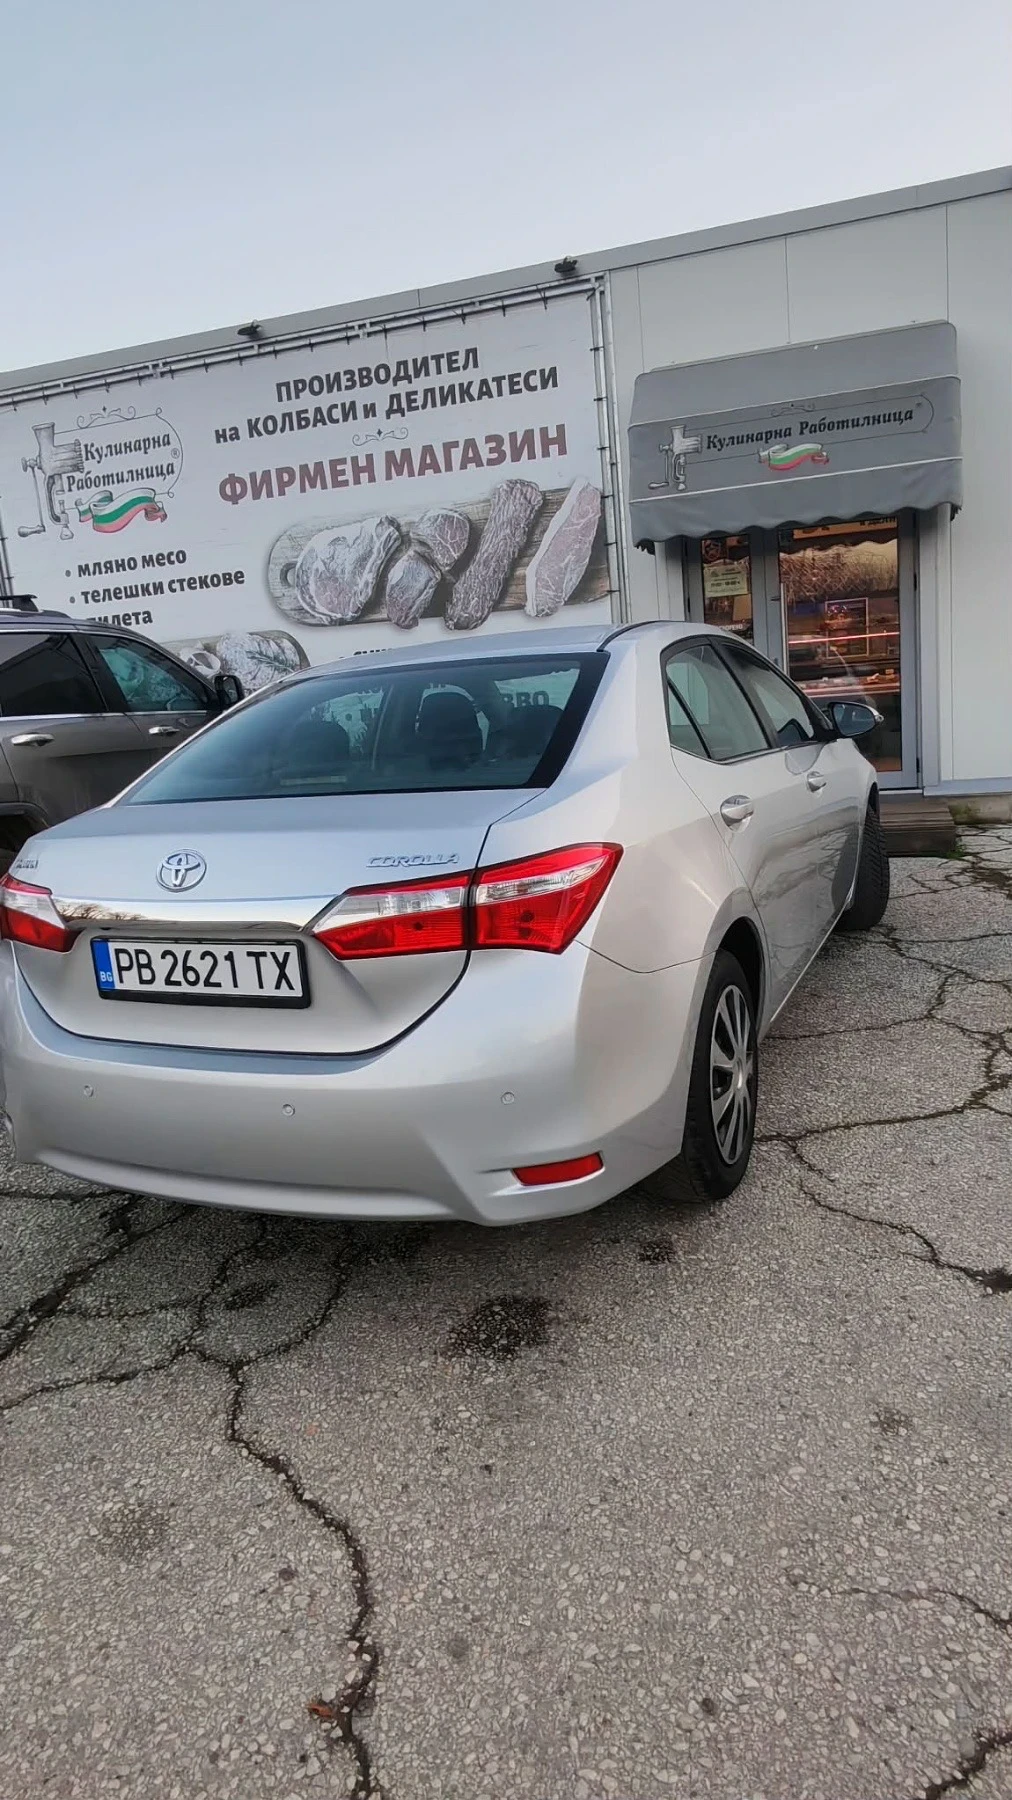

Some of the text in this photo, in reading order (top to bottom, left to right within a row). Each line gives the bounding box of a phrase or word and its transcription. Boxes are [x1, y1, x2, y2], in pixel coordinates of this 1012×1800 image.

[276, 347, 479, 402] ПРОИЗВОДИТЕЛ
[215, 366, 558, 444] на КОЛБАСИ и ДЕЛИКАТЕСИ
[706, 408, 913, 451] Кулинарна Работилница
[83, 433, 171, 464] Кулинарна
[219, 423, 567, 505] ФИРМЕН МАГАЗИН
[66, 462, 175, 492] Работилница
[77, 549, 187, 578] мляно месо
[81, 570, 245, 604] телешки стекове
[366, 853, 459, 868] COROLLA
[100, 971, 113, 982] BG
[114, 948, 295, 990] PB 2621 TX
